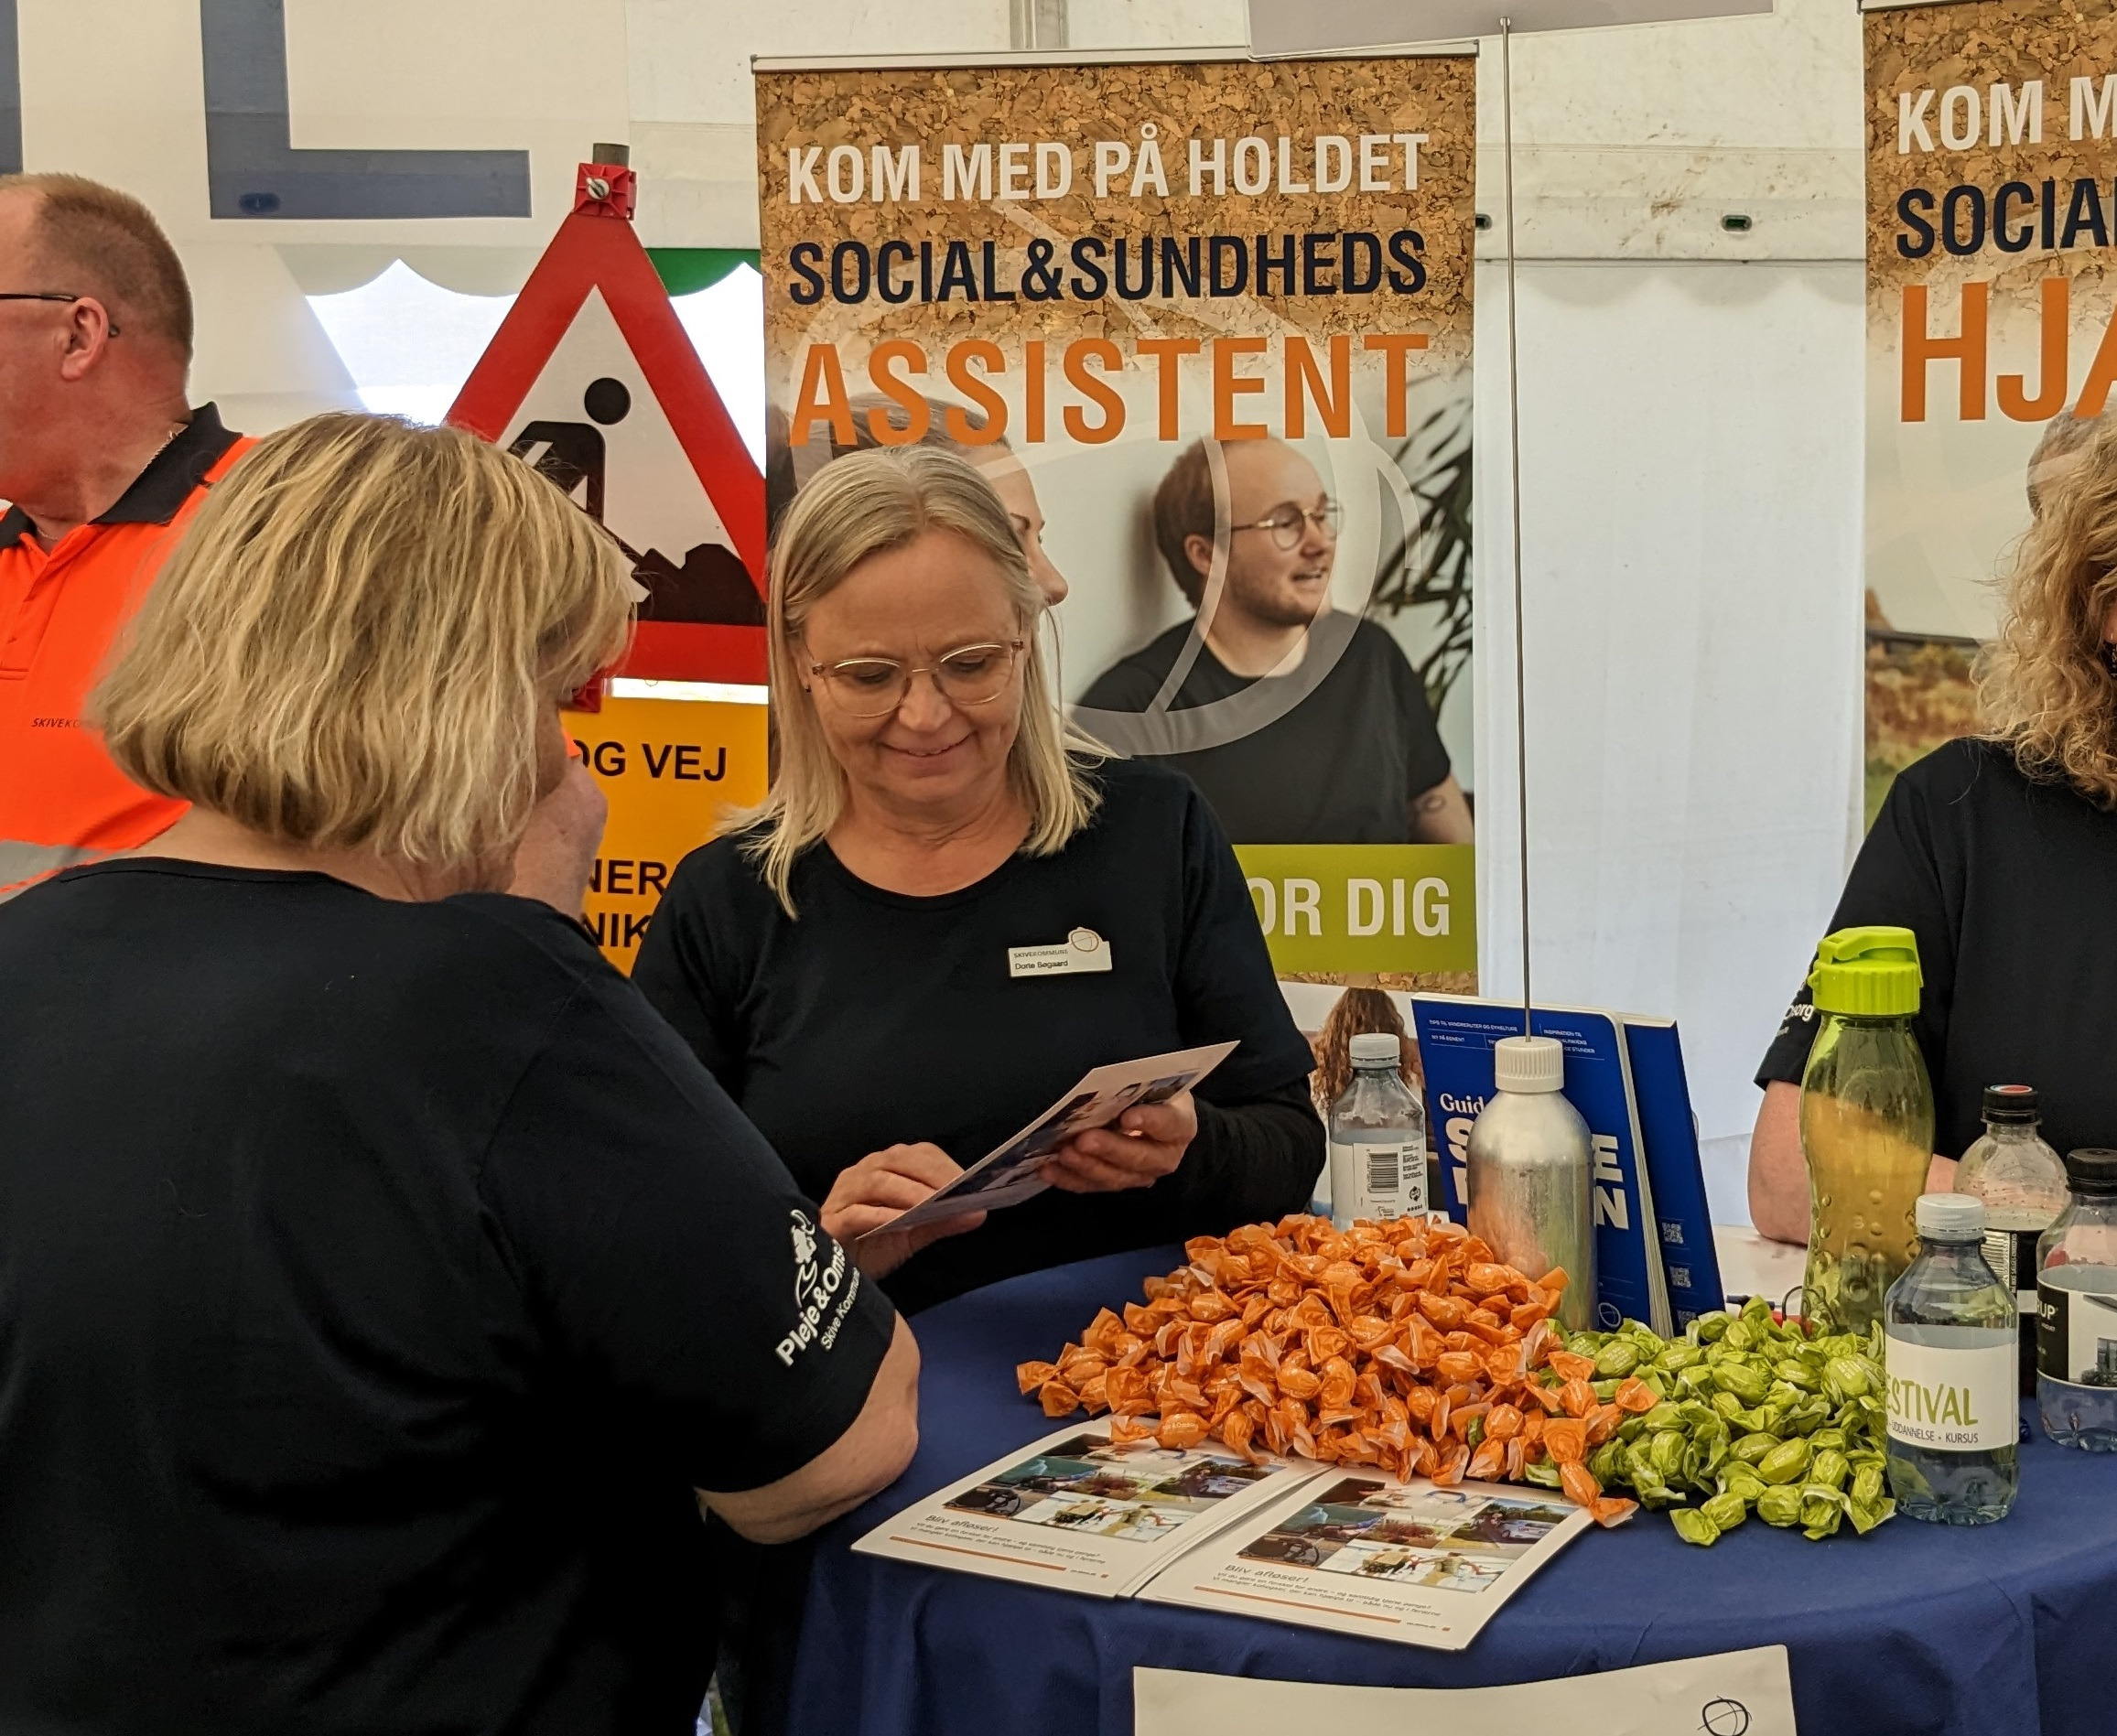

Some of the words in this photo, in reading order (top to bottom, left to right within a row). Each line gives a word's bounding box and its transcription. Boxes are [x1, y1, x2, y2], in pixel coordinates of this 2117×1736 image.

[1897, 80, 2043, 155] KOM
[788, 145, 921, 203] KOM
[943, 141, 1074, 200] MED
[1095, 123, 1170, 199] PÅ
[1189, 133, 1430, 197] HOLDET
[1896, 174, 2117, 259] SOCIA
[789, 229, 1429, 305] SOCIAL&SUNDHEDS
[789, 333, 1430, 447] ASSISTENT
[642, 742, 727, 782] VEJ
[1347, 877, 1451, 937] DIG
[775, 1305, 820, 1367] Pleje
[813, 1286, 831, 1310] &
[821, 1317, 842, 1352] Skive
[1945, 1432, 1979, 1444] KURSUS
[924, 1515, 950, 1524] Bliv
[1225, 1564, 1252, 1573] Bliv
[1254, 1570, 1310, 1583] afløser!
